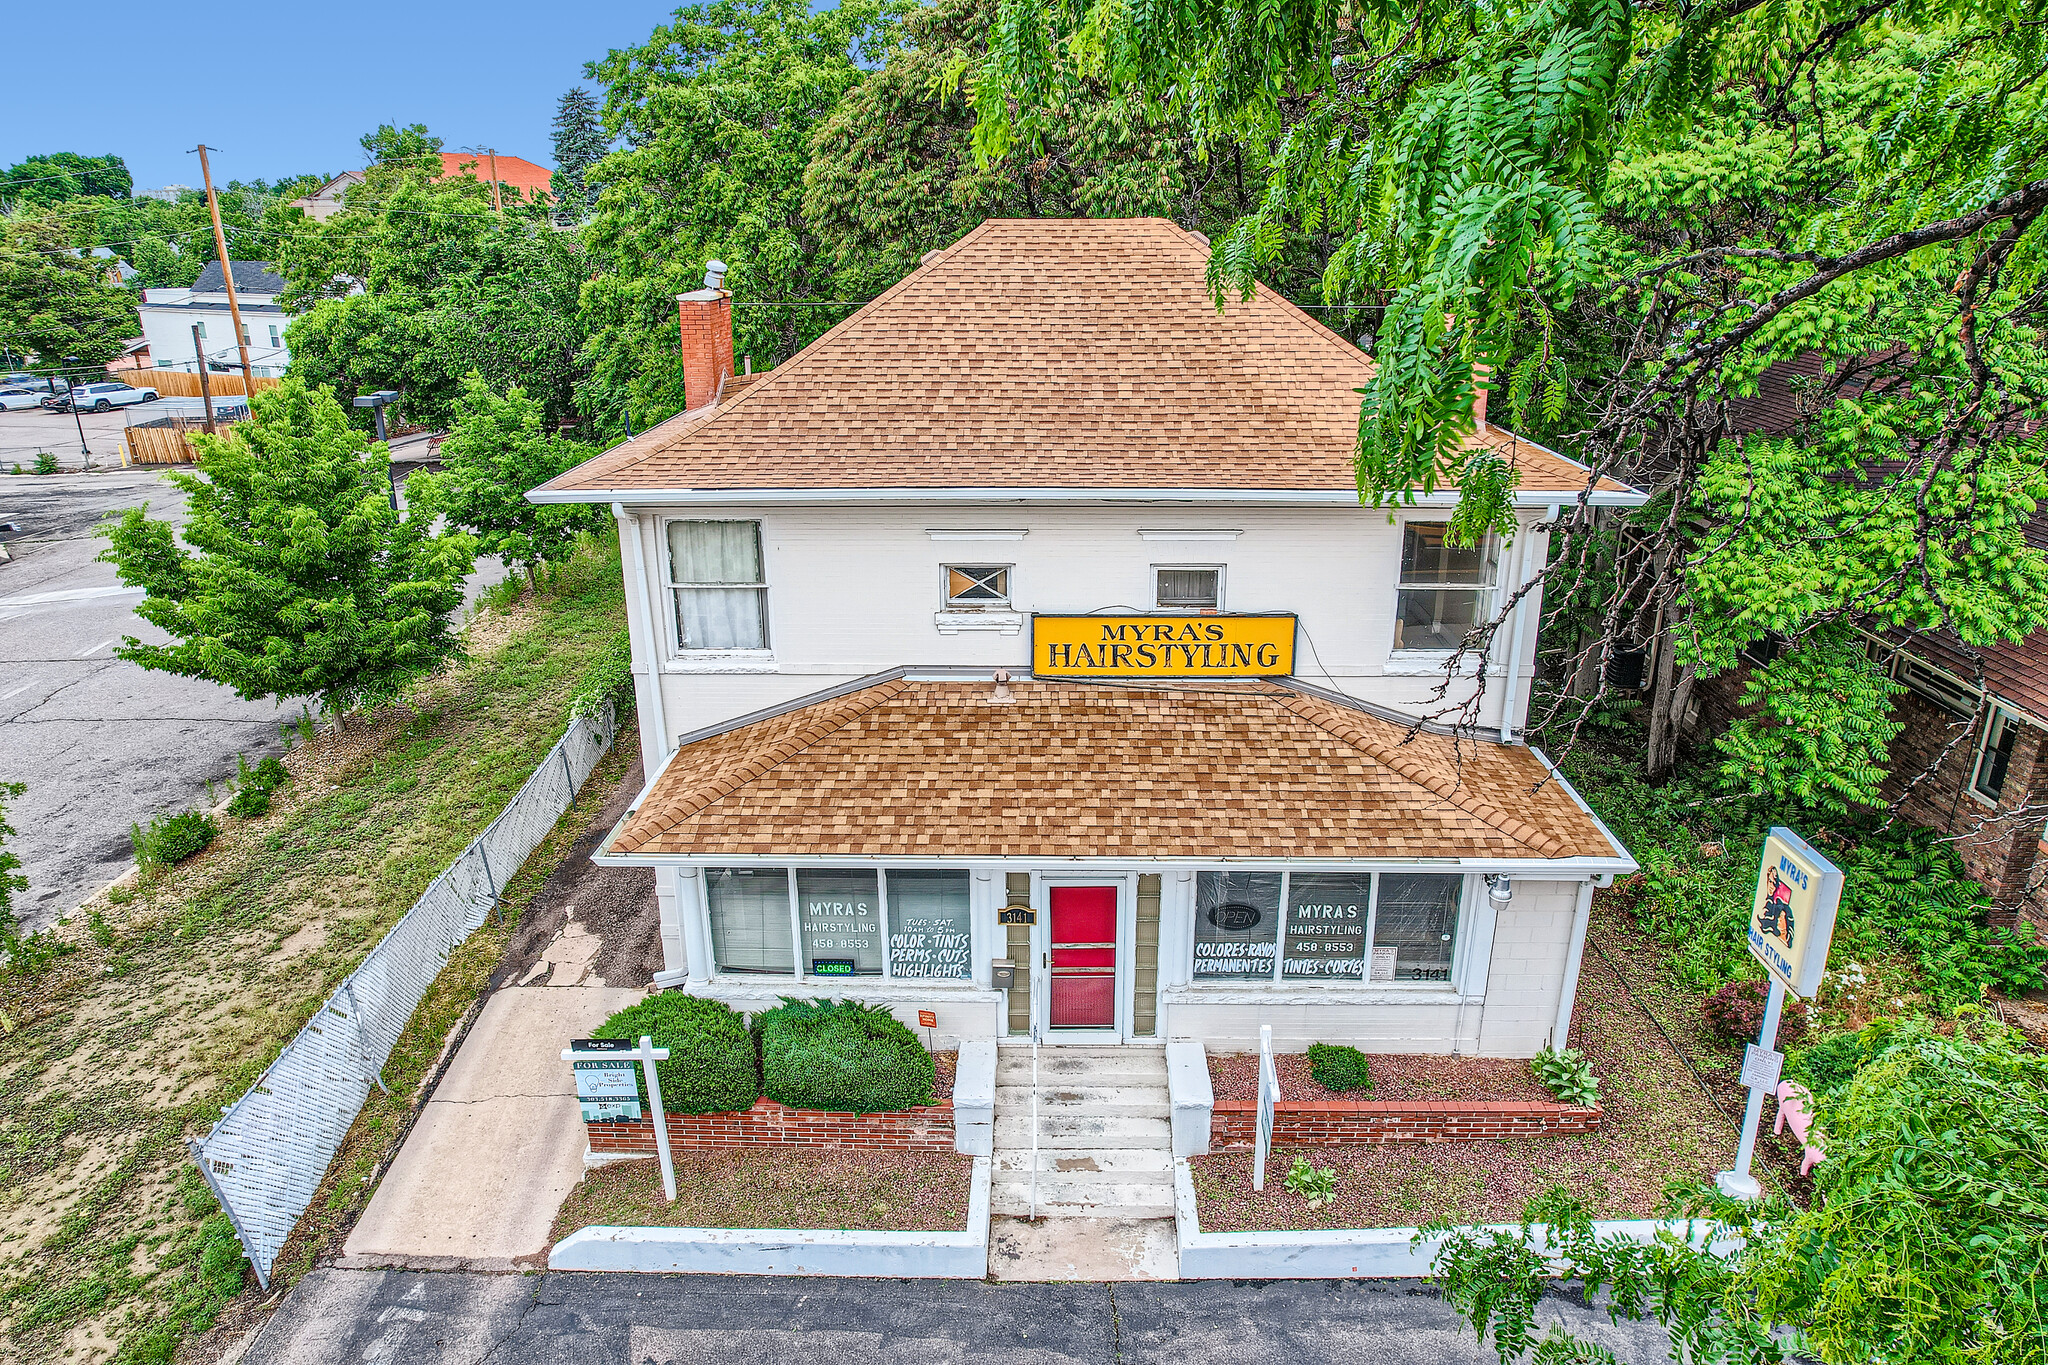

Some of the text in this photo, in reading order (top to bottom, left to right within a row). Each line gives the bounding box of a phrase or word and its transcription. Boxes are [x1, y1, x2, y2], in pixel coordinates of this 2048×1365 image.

[1101, 622, 1224, 641] MYRA'S
[1048, 643, 1280, 668] HAIRSTYLING
[1779, 855, 1808, 890] MYRA'S
[906, 918, 928, 926] TUES
[1006, 912, 1028, 923] 3141
[1214, 911, 1256, 924] OPEN
[804, 922, 876, 933] HAIRSTYLING
[1289, 925, 1362, 935] HAIRSTYLING
[890, 933, 970, 949] COLOR TINTS
[891, 949, 970, 965] PERMS CUTS
[1195, 942, 1247, 957] COLORES
[1748, 925, 1792, 979] HAIR STYLING
[816, 964, 851, 973] CLOSED
[892, 963, 964, 978] HIGHLIGHTS
[1194, 959, 1273, 973] PERMANENTES
[1283, 958, 1320, 974] TINTES
[1324, 958, 1365, 976] CORTES
[1412, 968, 1448, 980] 3141
